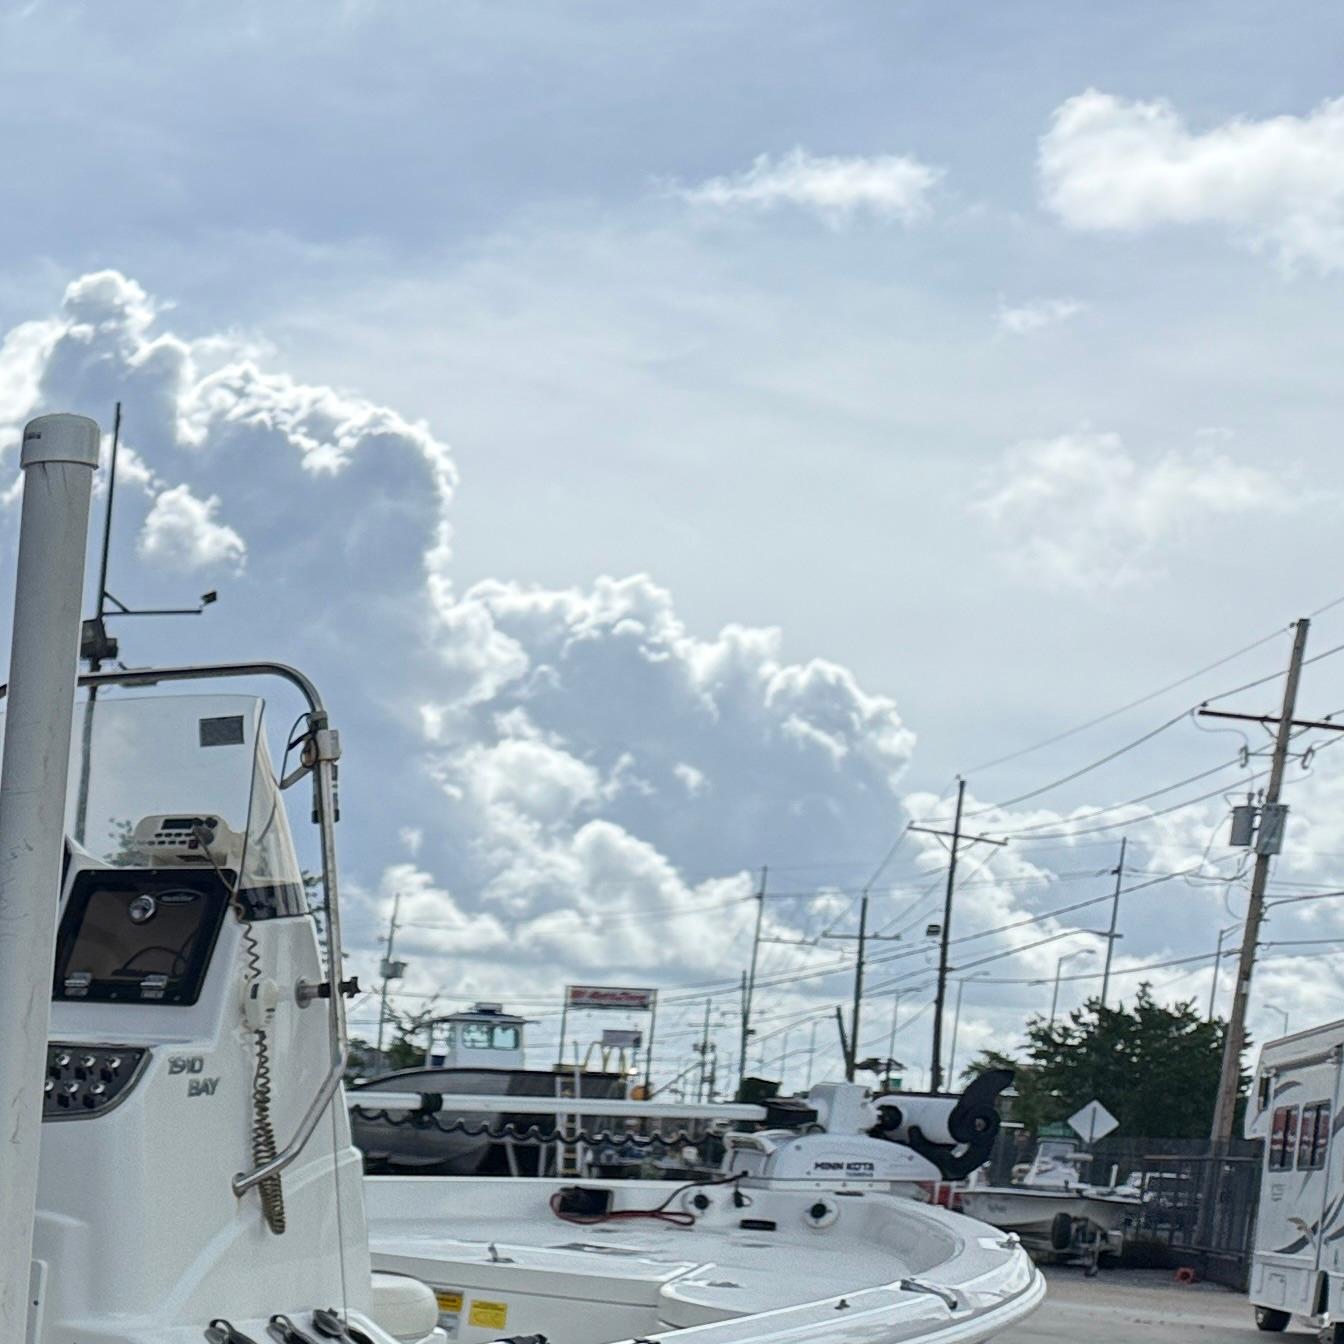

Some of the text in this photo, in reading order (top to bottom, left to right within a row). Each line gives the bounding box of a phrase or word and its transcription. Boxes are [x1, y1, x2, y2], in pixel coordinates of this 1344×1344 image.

[187, 1077, 221, 1097] BAY
[814, 1162, 875, 1171] MINN KOTA
